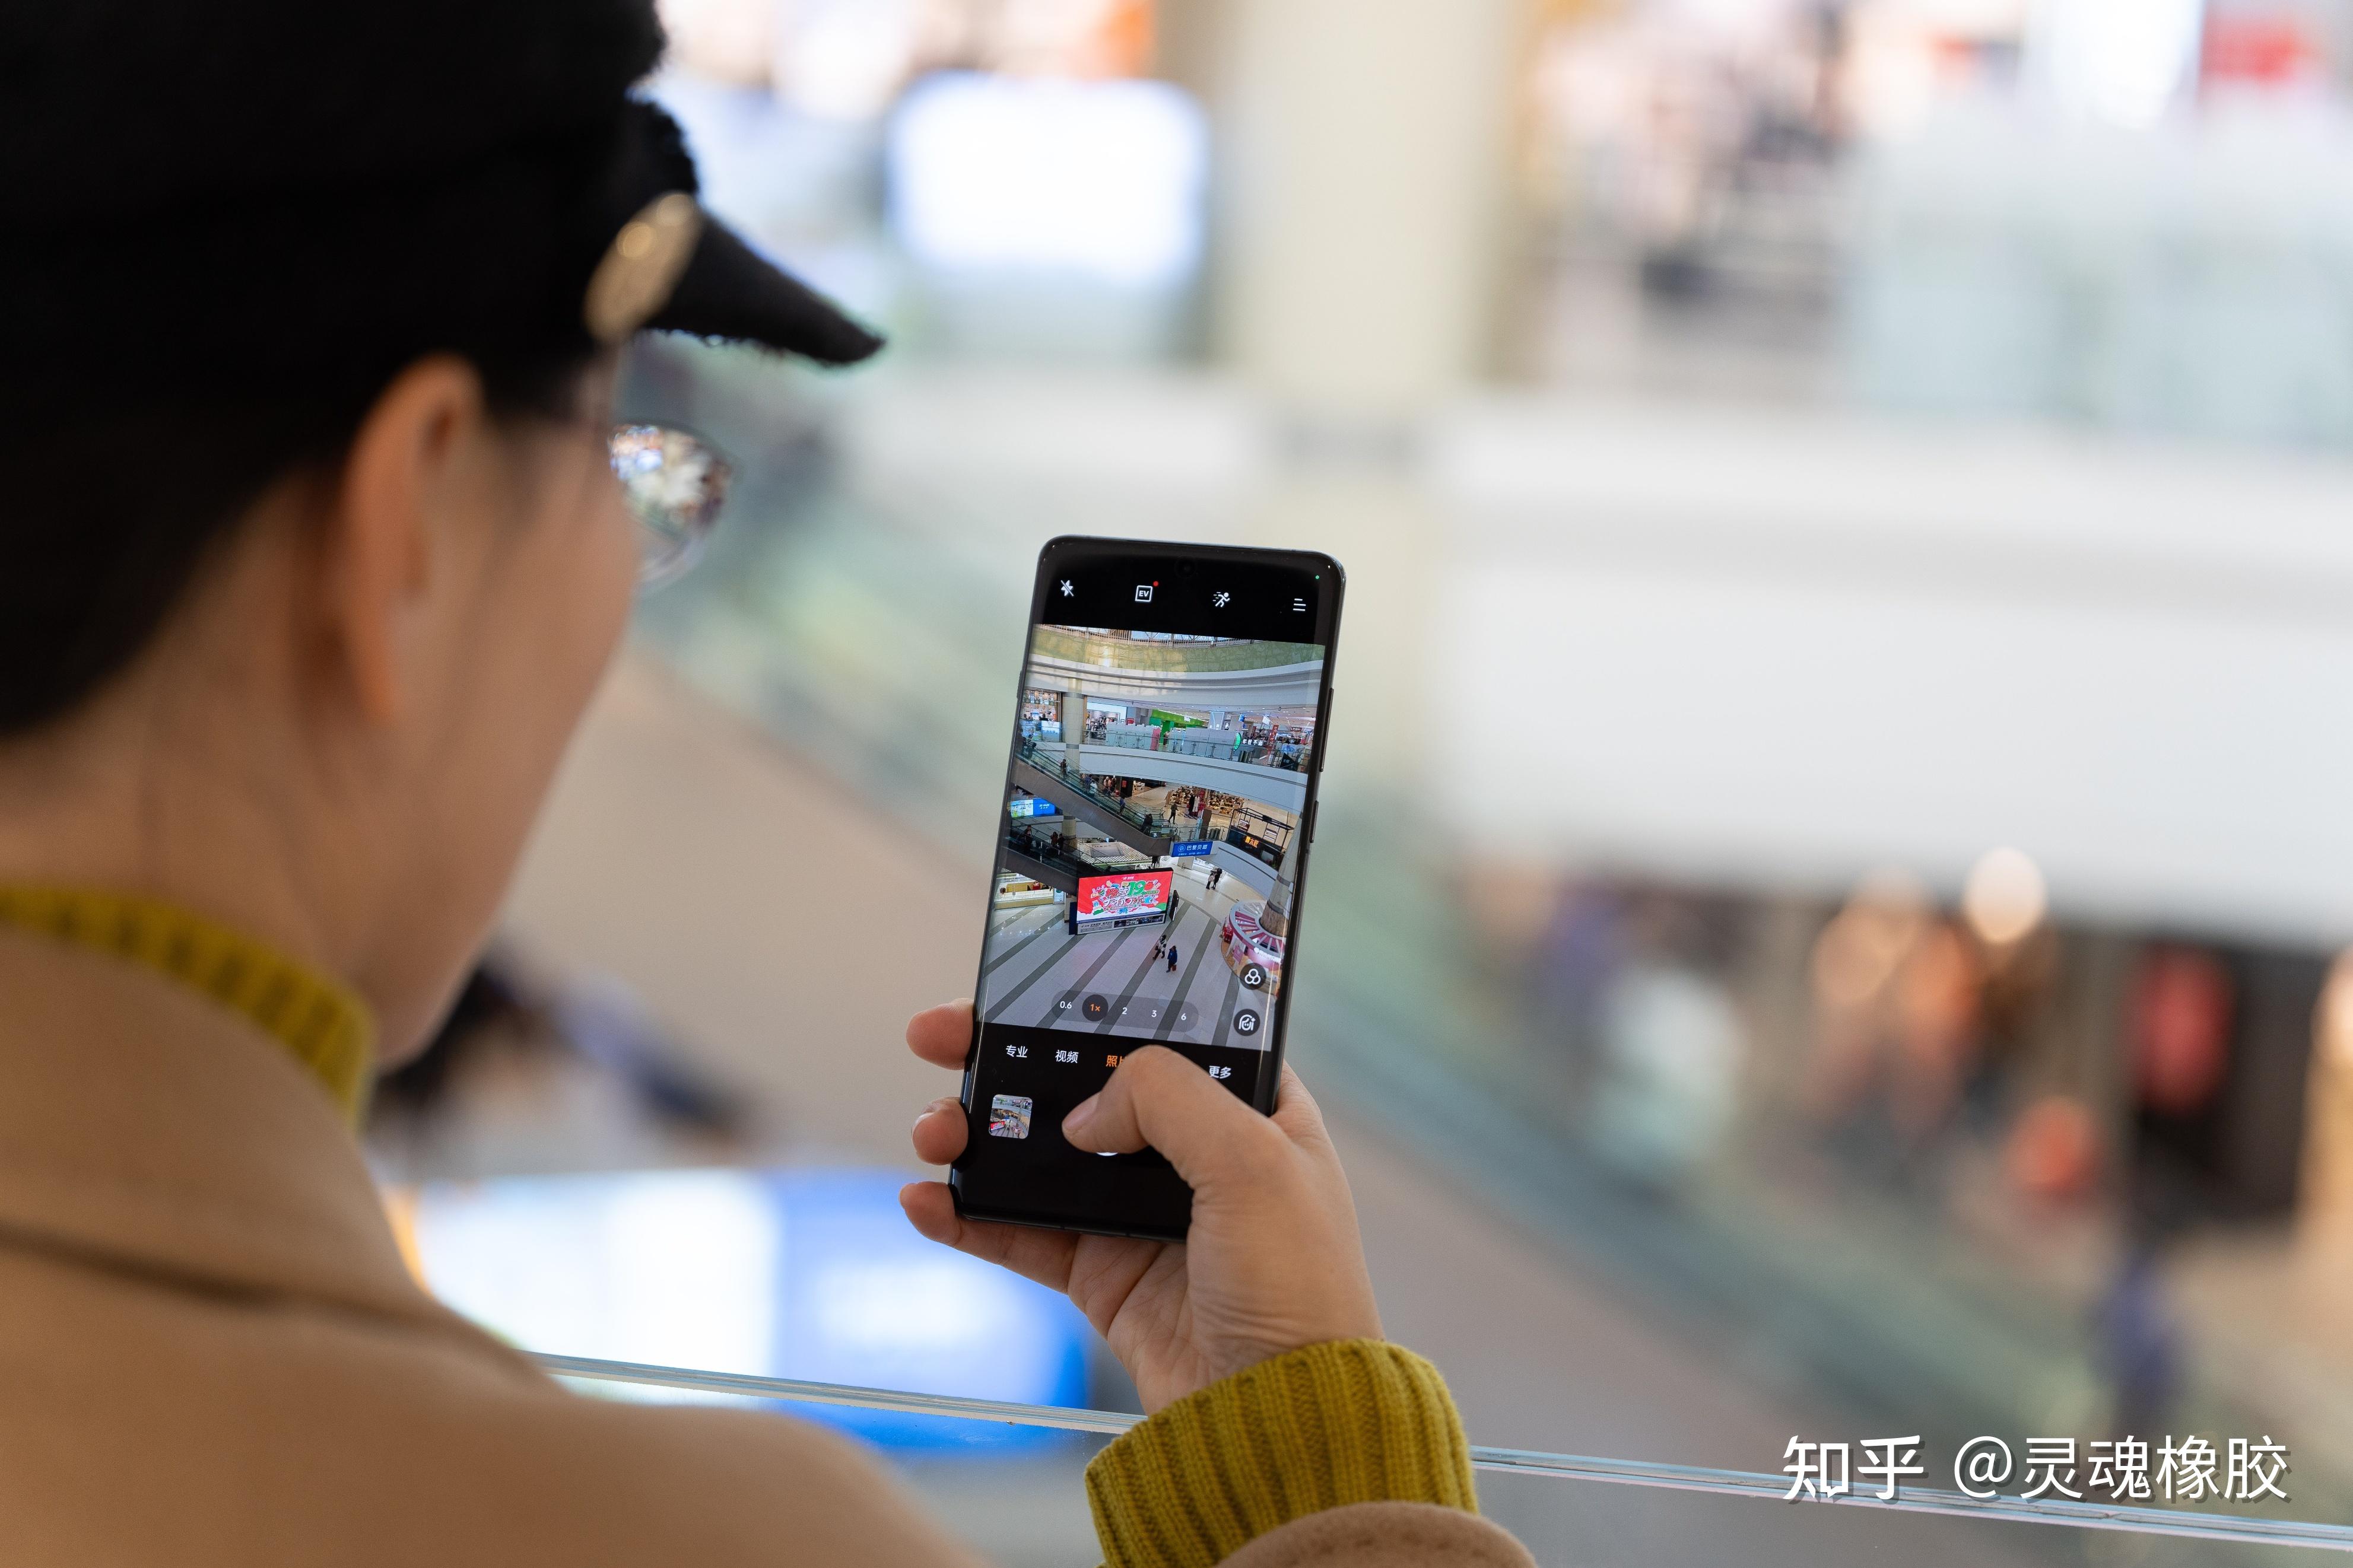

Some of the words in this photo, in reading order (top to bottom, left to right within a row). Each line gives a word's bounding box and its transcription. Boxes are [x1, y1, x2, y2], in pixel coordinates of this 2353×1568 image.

[1060, 1001, 1072, 1009] 0.6
[1006, 1045, 1028, 1057] 专业
[1055, 1049, 1079, 1064] 视频
[1209, 1066, 1231, 1079] 更多
